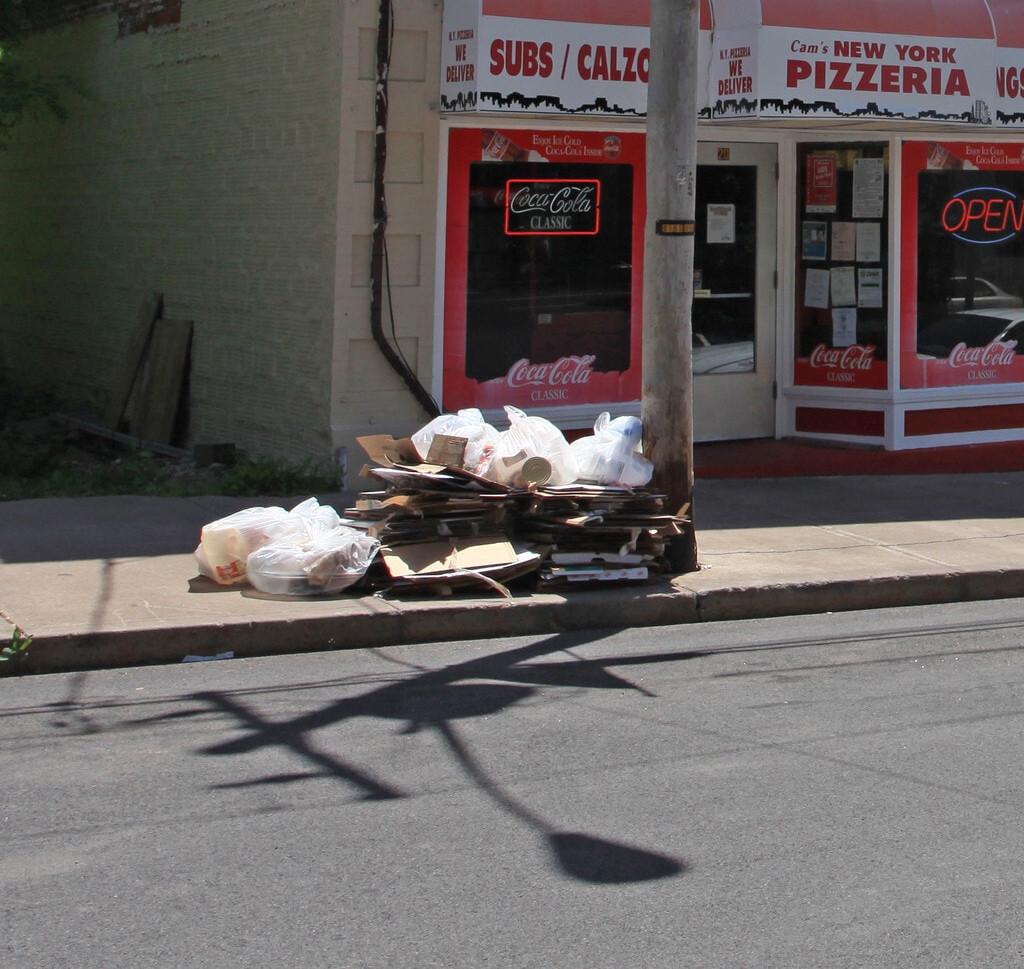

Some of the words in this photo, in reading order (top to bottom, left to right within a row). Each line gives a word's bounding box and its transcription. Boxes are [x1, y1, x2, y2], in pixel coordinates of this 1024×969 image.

[455, 44, 467, 61] WE
[489, 38, 553, 78] SUBS
[560, 43, 570, 80] /
[790, 39, 829, 54] Cam's
[833, 40, 886, 60] NEW
[895, 44, 957, 64] YORK
[446, 63, 475, 83] DELIVER
[729, 59, 743, 77] WE
[786, 59, 971, 97] PIZZERIA
[718, 76, 753, 96] DELIVER
[510, 186, 595, 214] Coca-Cola
[530, 215, 572, 230] CLASSIC
[810, 344, 875, 370] Coca-Cola
[949, 339, 1018, 368] Coca-Cola
[507, 354, 596, 388] Coca-Cola
[827, 372, 856, 382] CLASSIC
[967, 370, 997, 380] CLASSIC
[531, 389, 569, 401] CLASSIC
